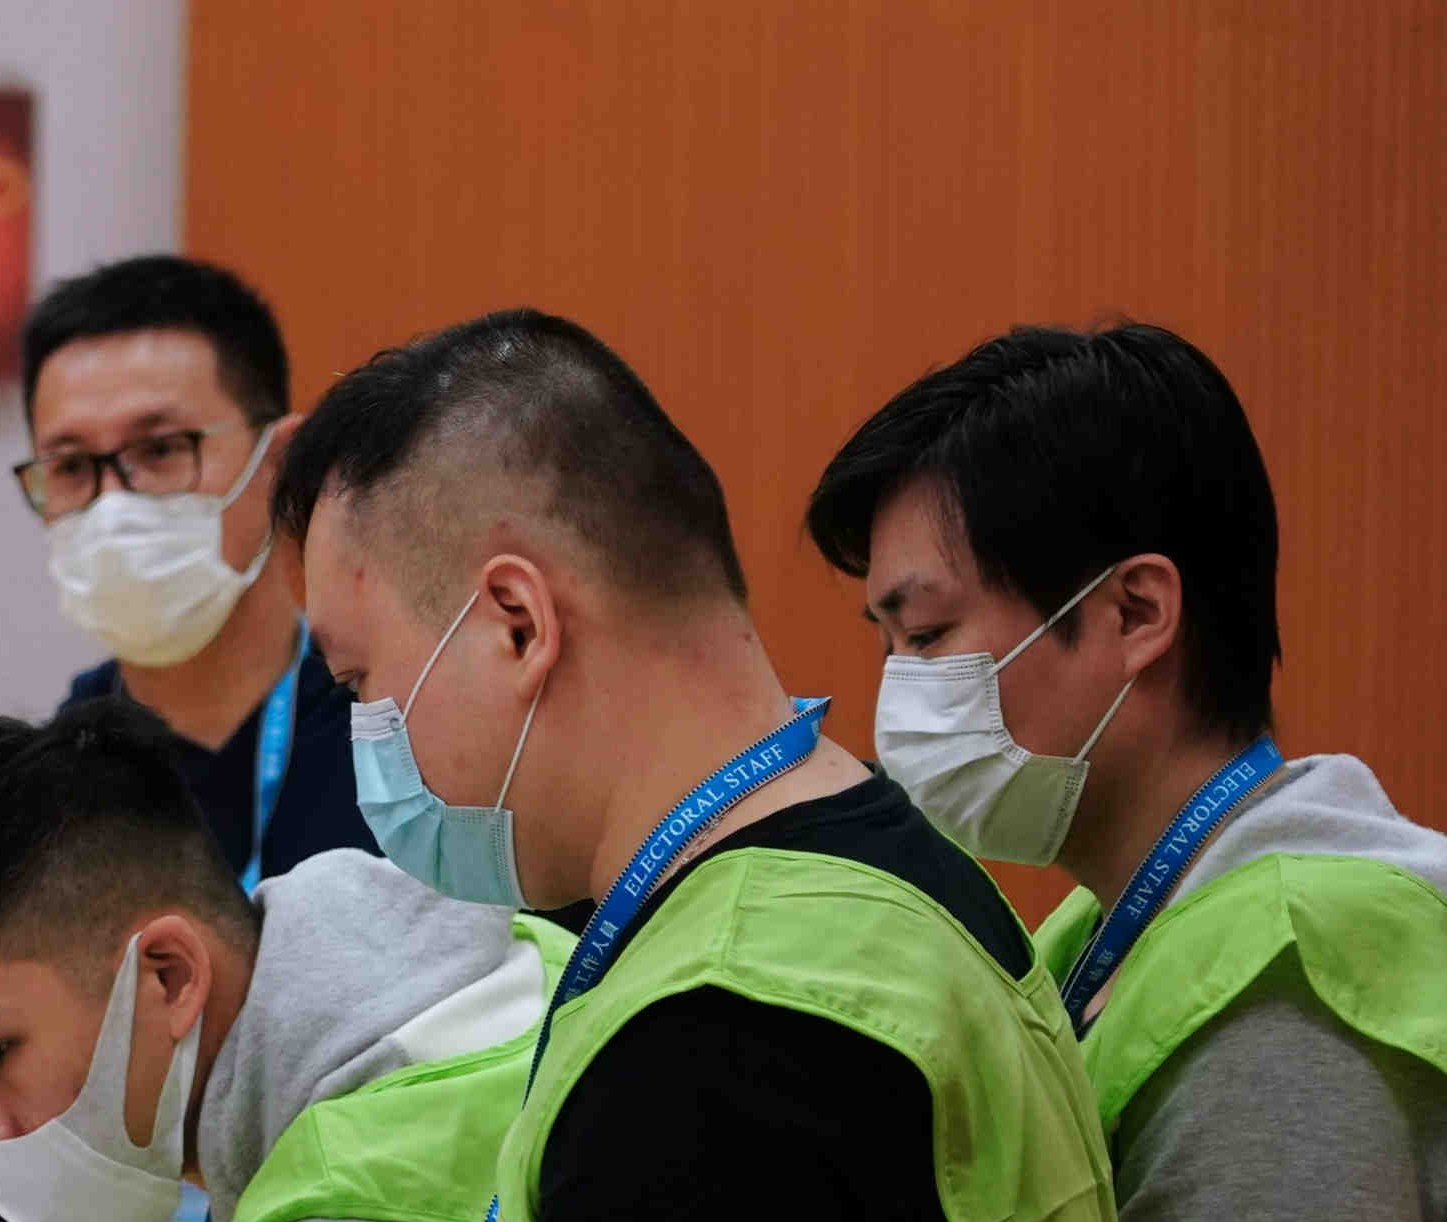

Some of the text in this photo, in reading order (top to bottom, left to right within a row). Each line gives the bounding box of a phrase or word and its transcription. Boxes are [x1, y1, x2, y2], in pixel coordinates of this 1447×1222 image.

[624, 743, 785, 897] ELECTORAL STAFF
[1127, 761, 1256, 920] ELECTORAL STAFF
